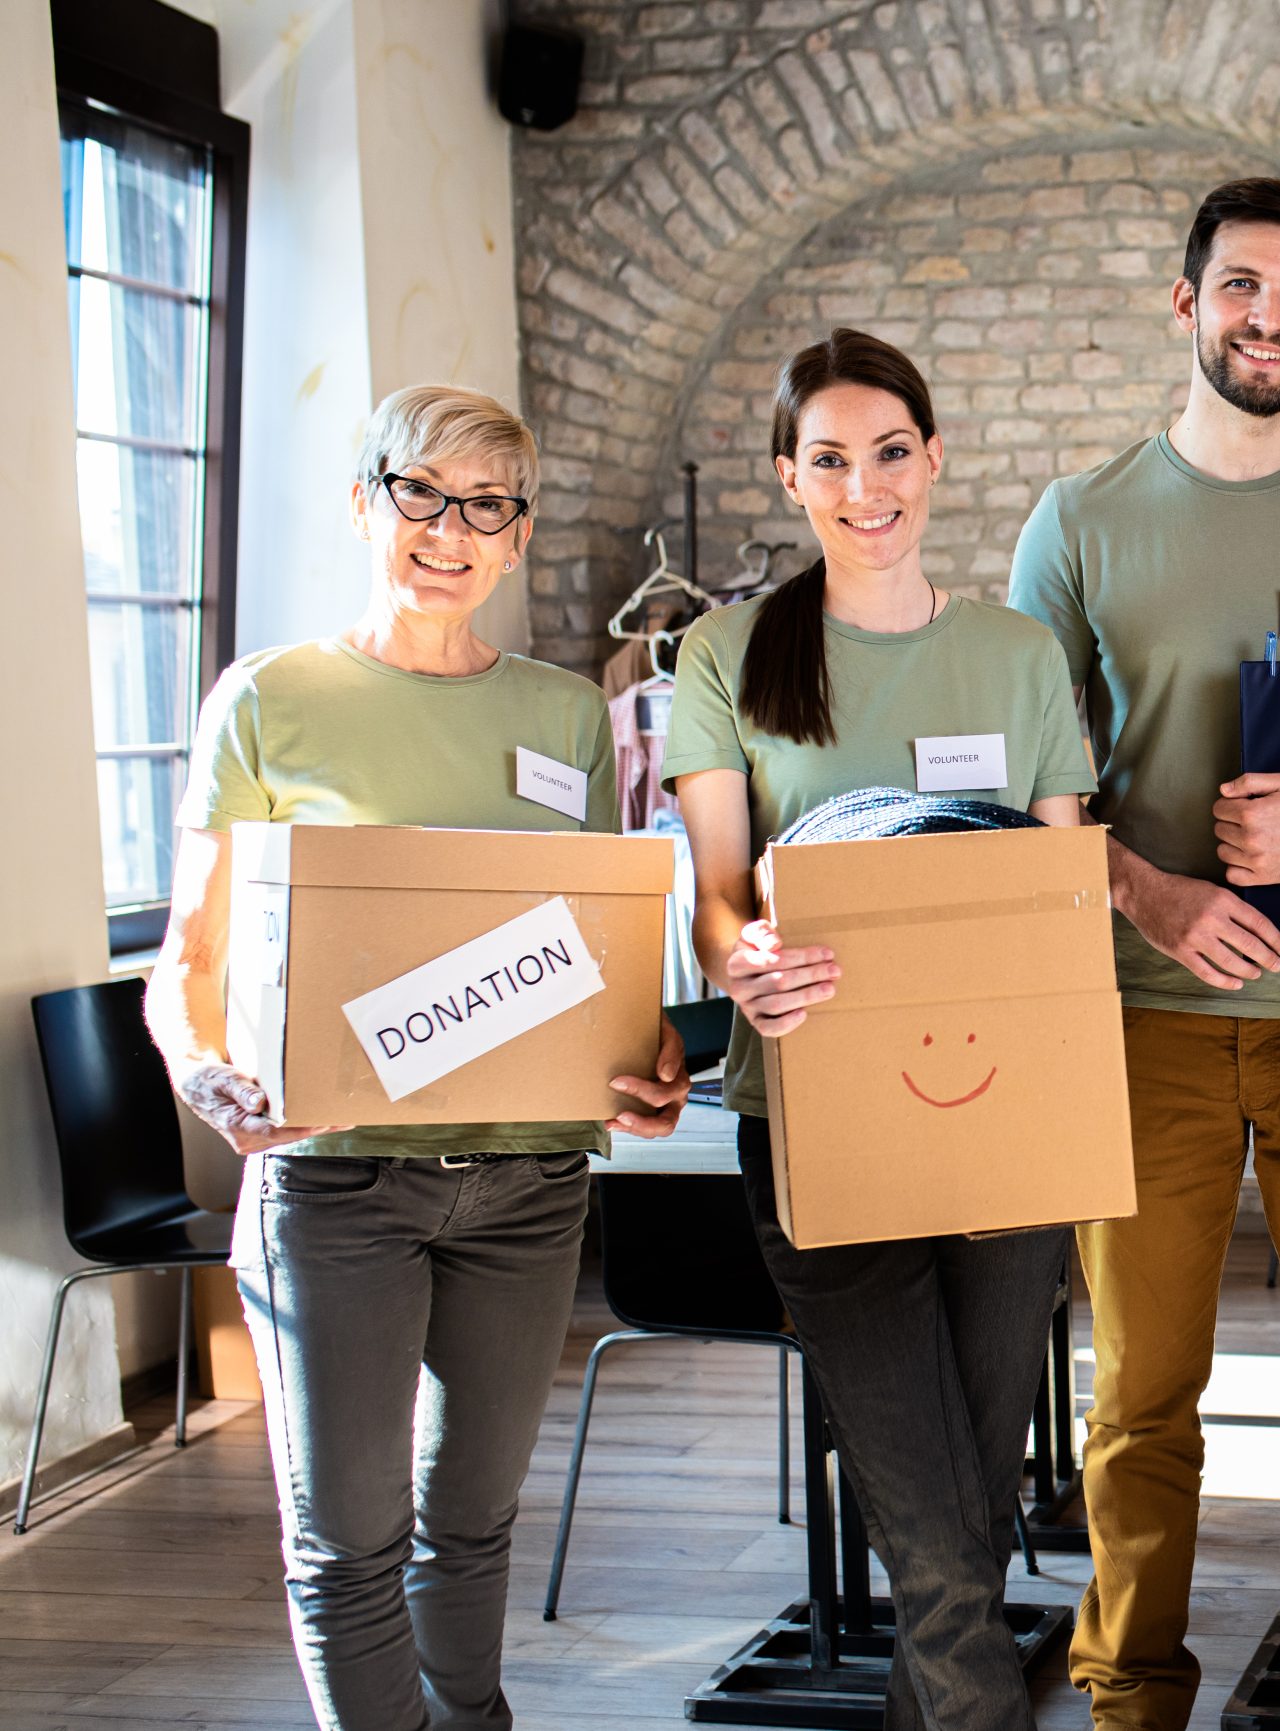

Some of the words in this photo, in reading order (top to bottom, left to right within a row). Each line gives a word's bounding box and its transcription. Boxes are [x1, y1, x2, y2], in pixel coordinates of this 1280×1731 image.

[928, 754, 980, 765] VOLUNTEER
[532, 769, 573, 792] VOLUNTEER
[376, 938, 573, 1060] DONATION
